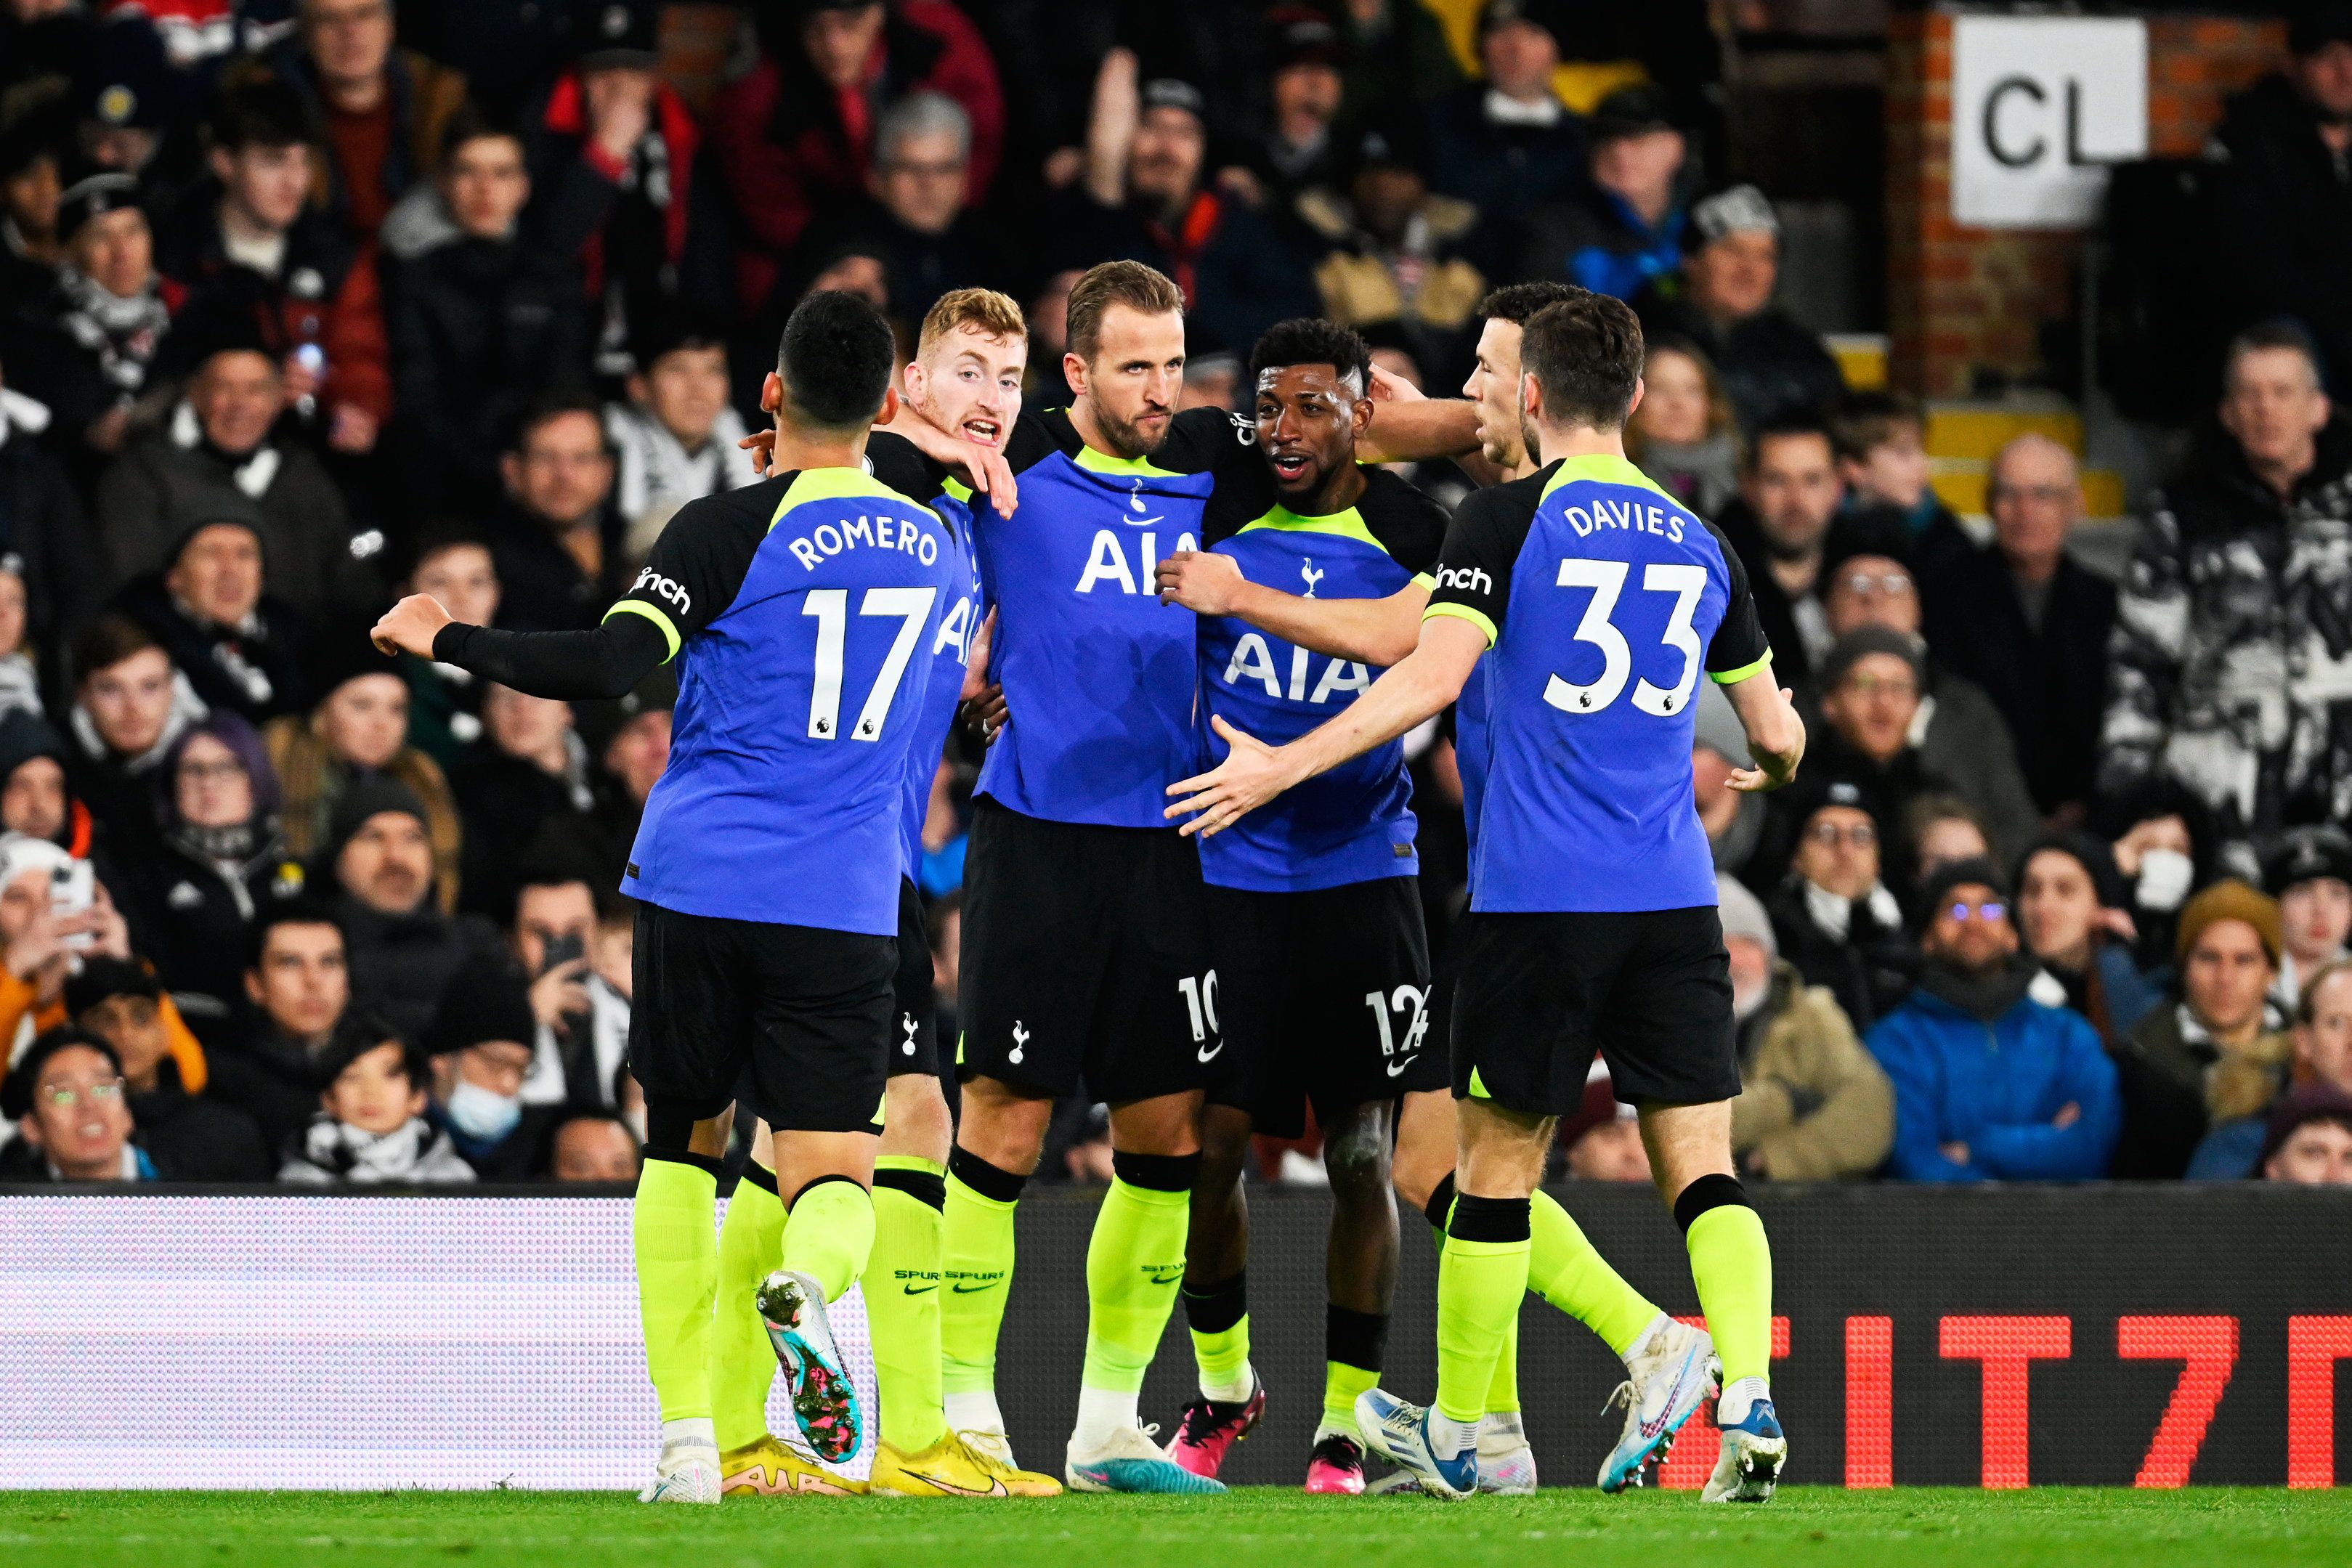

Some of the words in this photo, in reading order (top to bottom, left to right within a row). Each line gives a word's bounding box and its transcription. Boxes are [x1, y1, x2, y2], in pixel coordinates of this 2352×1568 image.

[1981, 73, 2115, 168] CL
[789, 515, 938, 572] ROMERO
[1563, 500, 1686, 543] DAVIES
[628, 566, 691, 615] inch
[802, 586, 937, 742] 17
[1222, 633, 1371, 704] AIA
[1542, 558, 1708, 717] 33
[1178, 969, 1220, 1041] 10
[894, 1270, 941, 1280] SPUR
